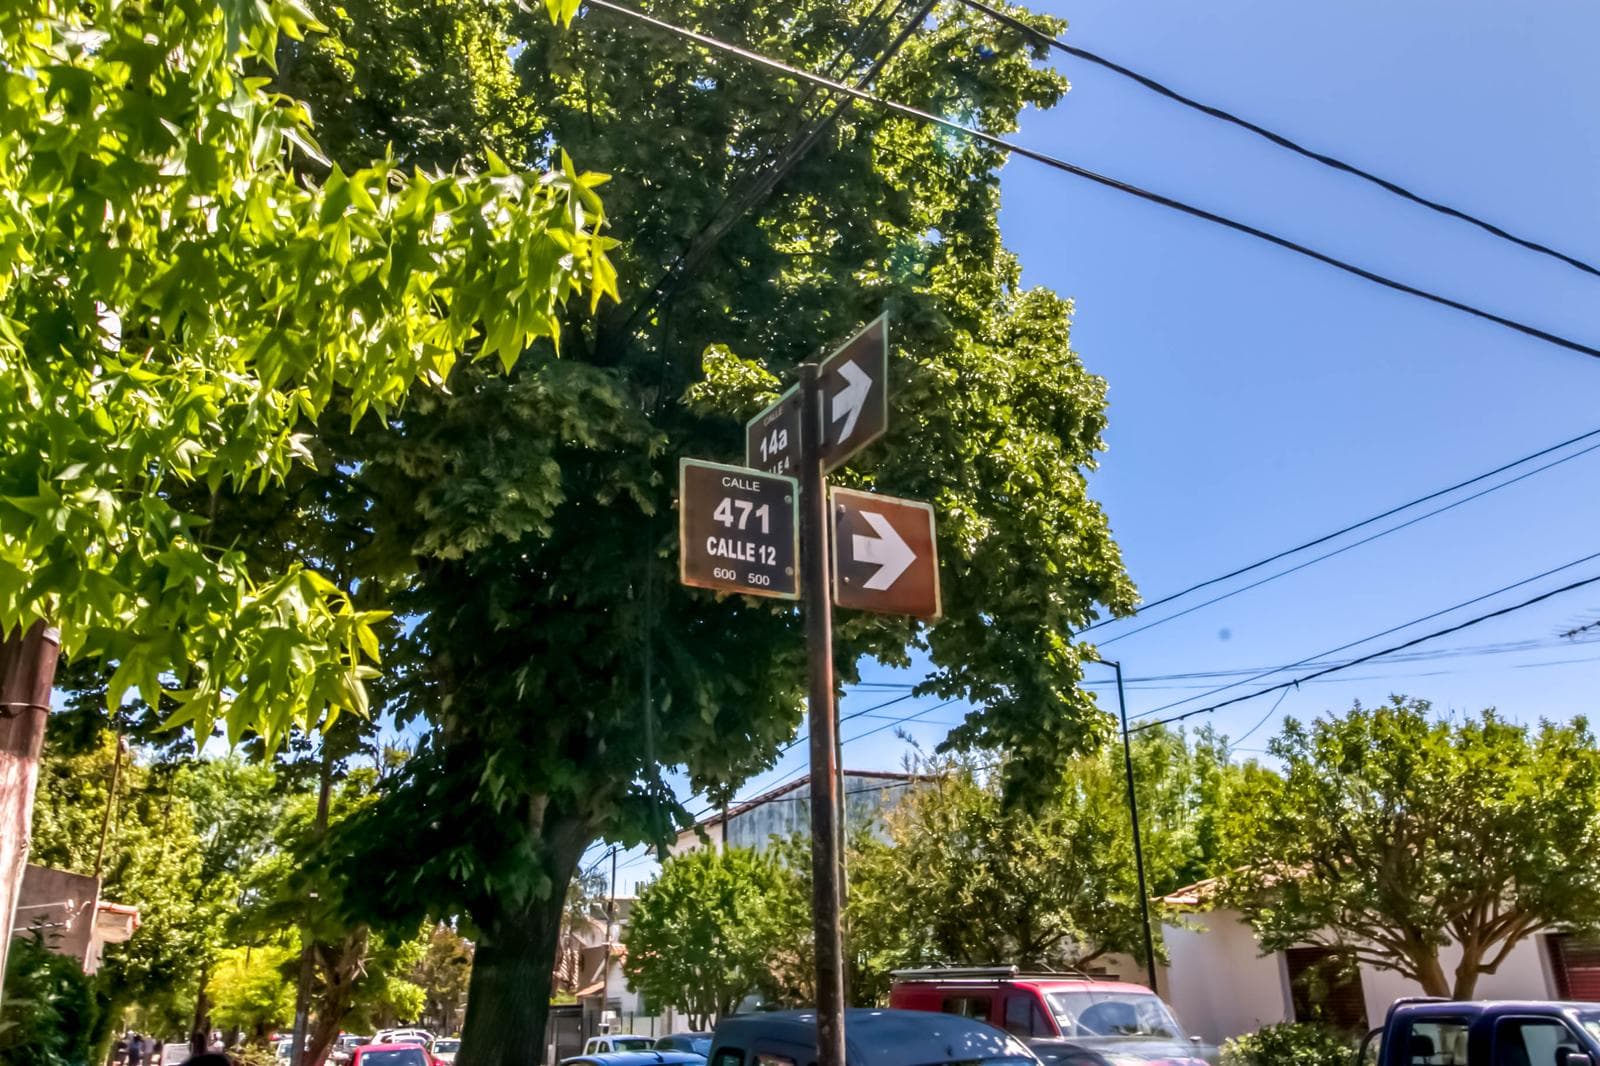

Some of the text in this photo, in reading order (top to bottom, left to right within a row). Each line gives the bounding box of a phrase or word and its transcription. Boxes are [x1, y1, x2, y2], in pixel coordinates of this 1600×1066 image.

[760, 429, 788, 462] 14a
[722, 477, 761, 492] CALLE
[713, 497, 770, 534] 471
[706, 536, 777, 566] CALLE 12
[713, 567, 770, 586] 600 500
